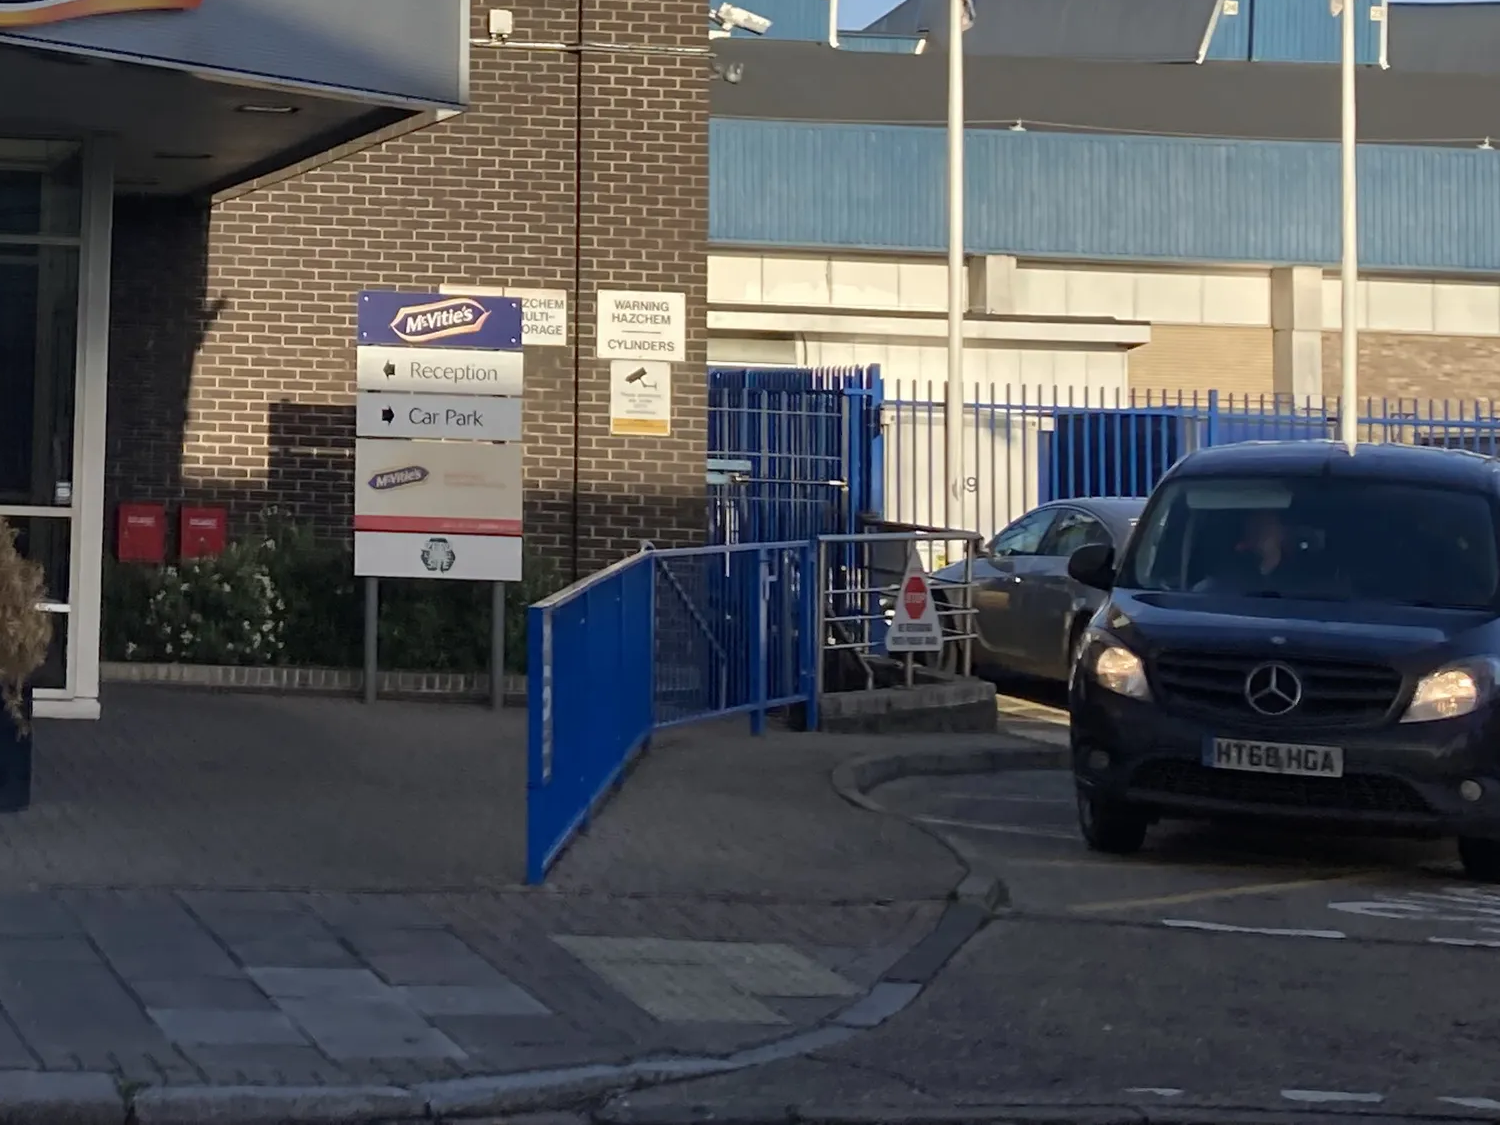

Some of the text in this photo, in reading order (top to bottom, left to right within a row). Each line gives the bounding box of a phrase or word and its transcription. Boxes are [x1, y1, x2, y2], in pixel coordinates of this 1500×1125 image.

[521, 297, 564, 310] ZCHEM
[614, 299, 669, 312] WARNING
[405, 305, 473, 334] McVitie's
[611, 313, 671, 325] HAZCHEM
[607, 339, 675, 352] CYLINDERS
[409, 361, 498, 383] Reception
[408, 407, 484, 427] Car Park
[1216, 741, 1335, 772] HT68 HGA
